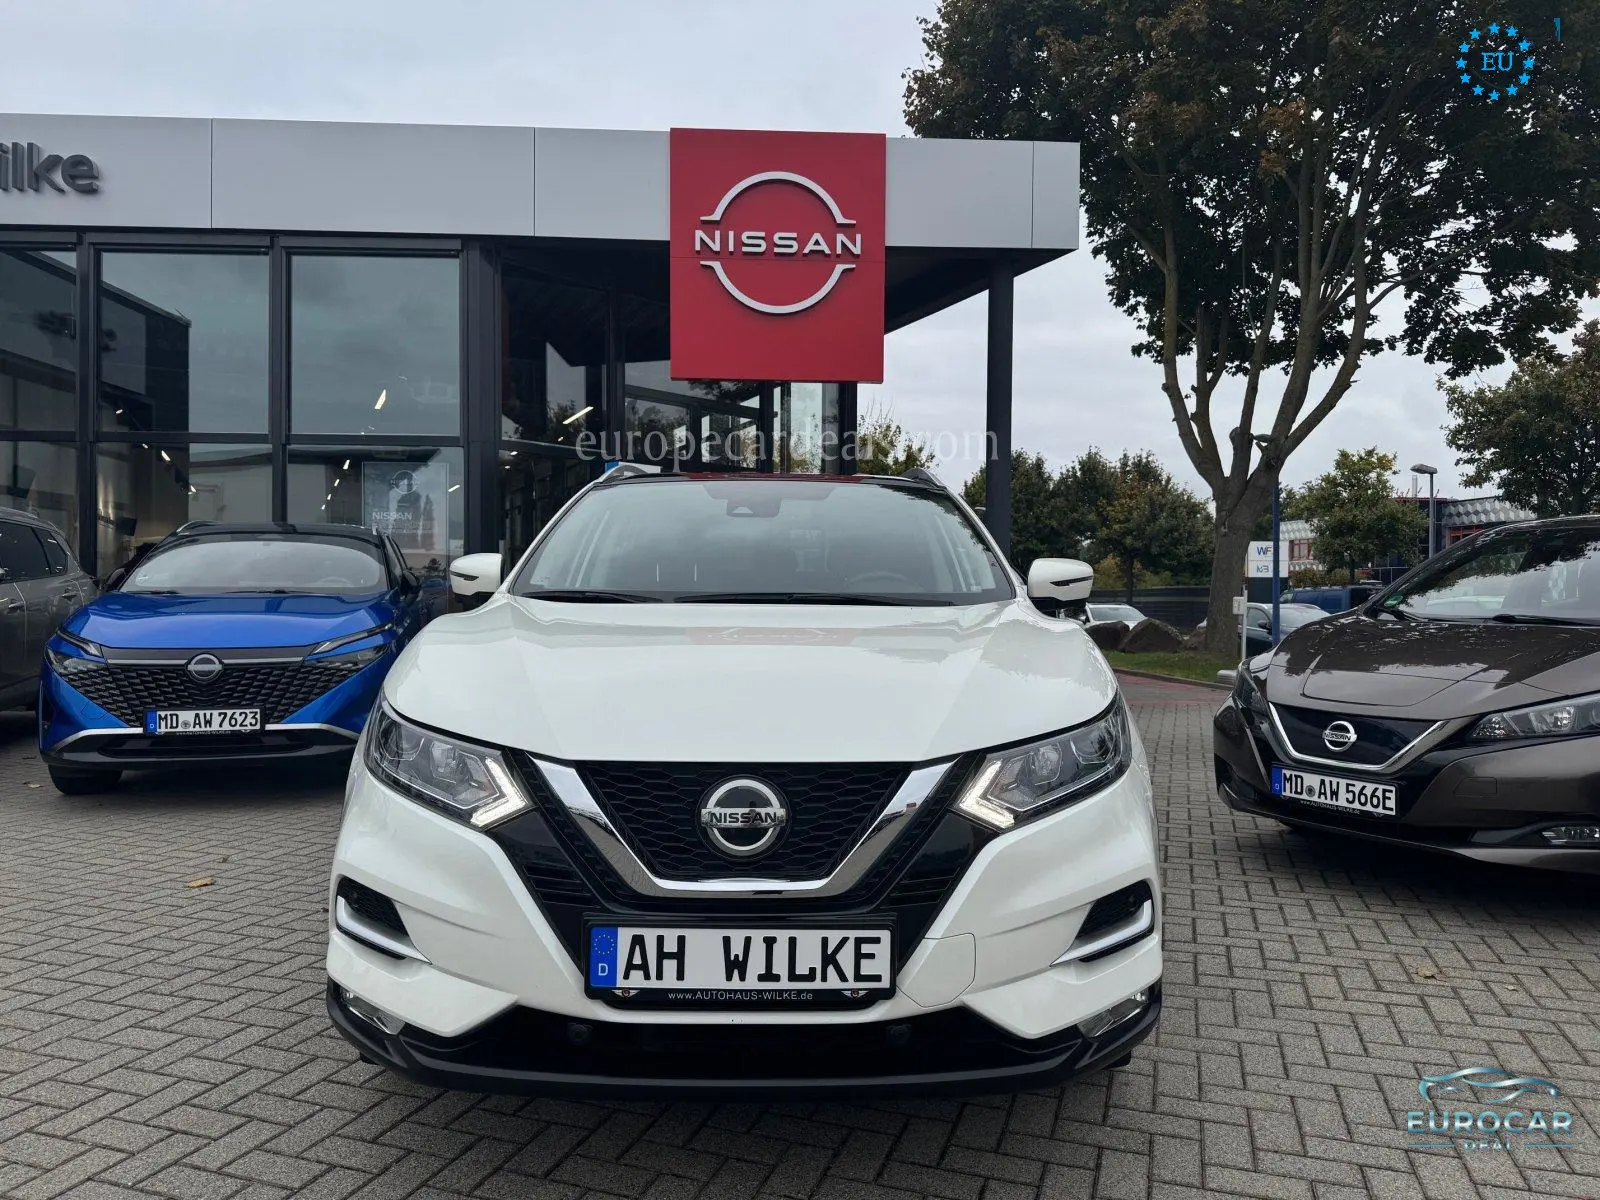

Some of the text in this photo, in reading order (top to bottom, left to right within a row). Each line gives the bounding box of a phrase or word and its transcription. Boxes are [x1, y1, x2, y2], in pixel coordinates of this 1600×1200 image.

[694, 229, 862, 256] NISSAN
[372, 511, 413, 521] NISSAN
[157, 710, 259, 730] MD AW 7623
[1282, 772, 1395, 812] MD AW 566E
[710, 811, 777, 824] NISSAN
[622, 934, 883, 982] AH WILKE
[597, 963, 609, 977] D
[667, 991, 814, 1001] www.AUTOHAUS-WILKE.de
